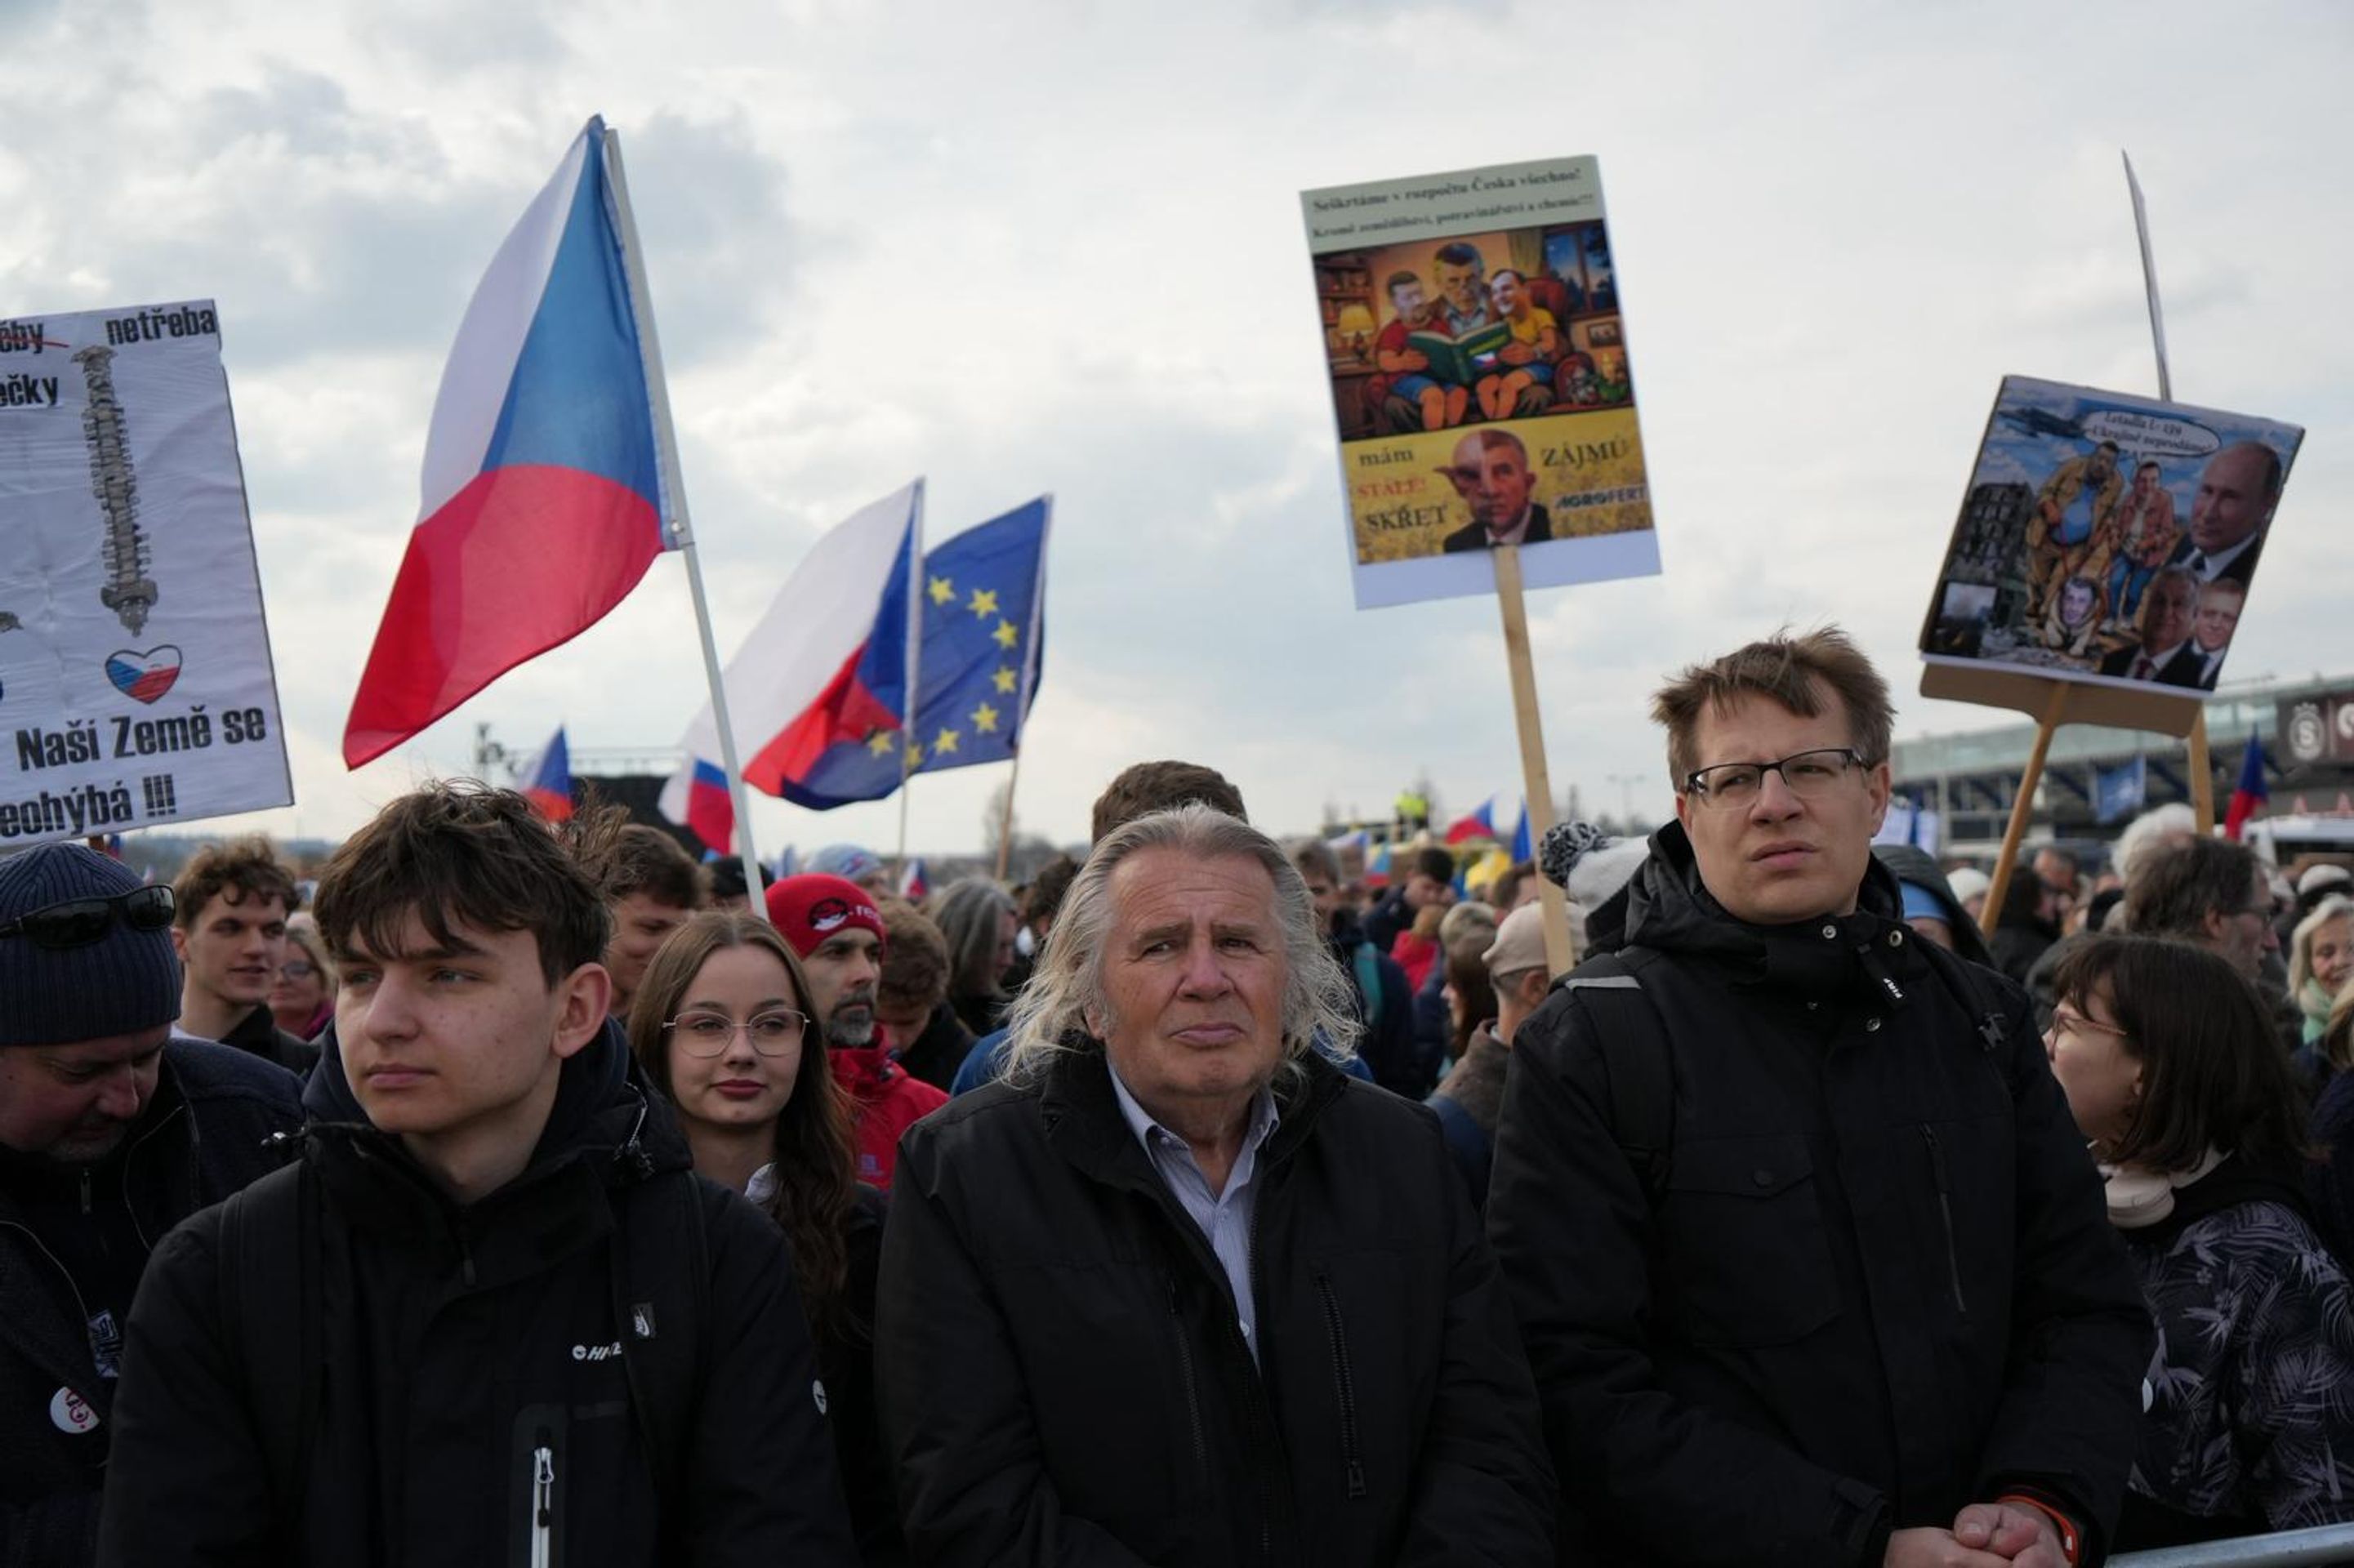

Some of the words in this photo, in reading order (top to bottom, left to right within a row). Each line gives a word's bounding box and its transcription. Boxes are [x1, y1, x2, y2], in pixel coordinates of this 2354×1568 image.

[105, 306, 217, 345] netřeba
[1359, 446, 1414, 466] mám
[16, 719, 100, 772] Naší
[110, 705, 212, 760] Země
[221, 707, 266, 745] se
[142, 774, 177, 817] !!!
